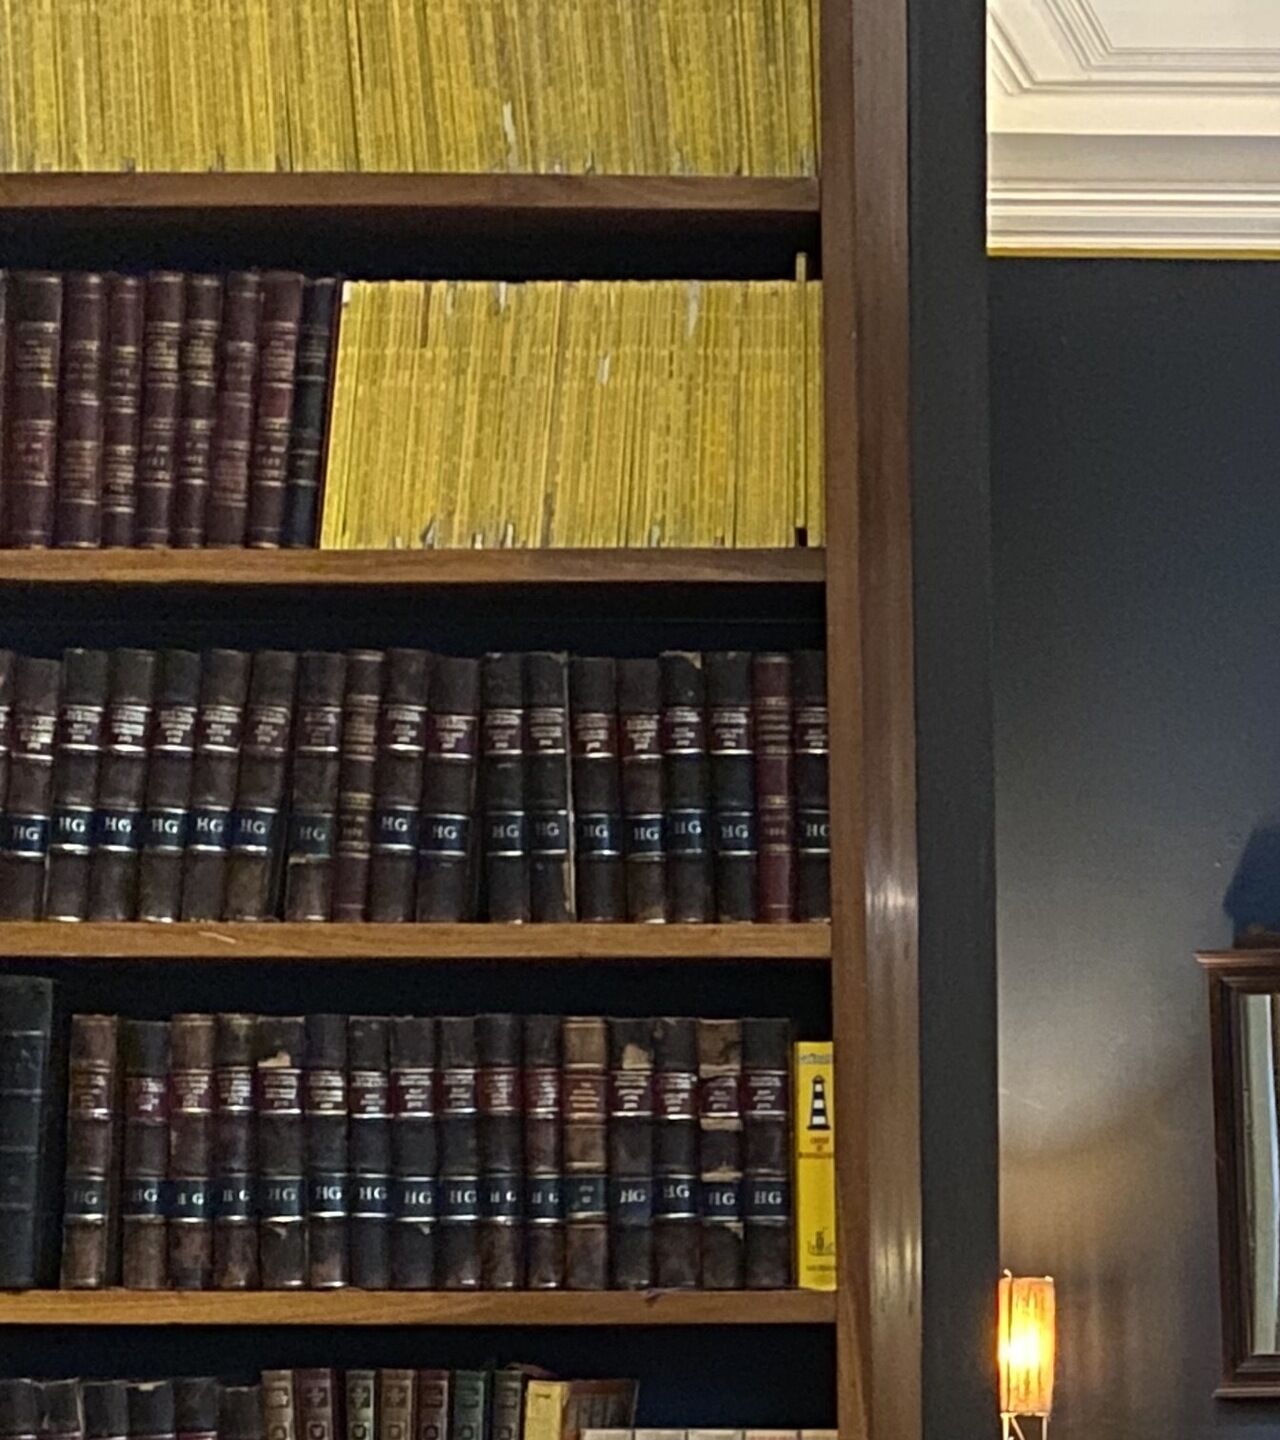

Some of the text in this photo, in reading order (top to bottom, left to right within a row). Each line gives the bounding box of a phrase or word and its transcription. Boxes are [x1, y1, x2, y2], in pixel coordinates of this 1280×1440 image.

[59, 818, 85, 833] HG
[105, 818, 131, 833] HG
[152, 818, 178, 834] HG
[197, 817, 223, 833] HG
[240, 818, 266, 834] HG
[382, 817, 408, 833] HG
[432, 825, 457, 840] HG
[583, 824, 608, 838] HG
[675, 820, 701, 835] HG
[722, 824, 748, 839] HG
[13, 826, 39, 842] HG
[634, 826, 659, 841] HG
[315, 1186, 342, 1200] HG
[360, 1186, 387, 1200] HG
[405, 1191, 432, 1205] HG
[450, 1189, 477, 1204] HG
[620, 1189, 645, 1204] HG
[664, 1184, 690, 1199] HG
[709, 1191, 735, 1206] HG
[754, 1190, 782, 1204] HG
